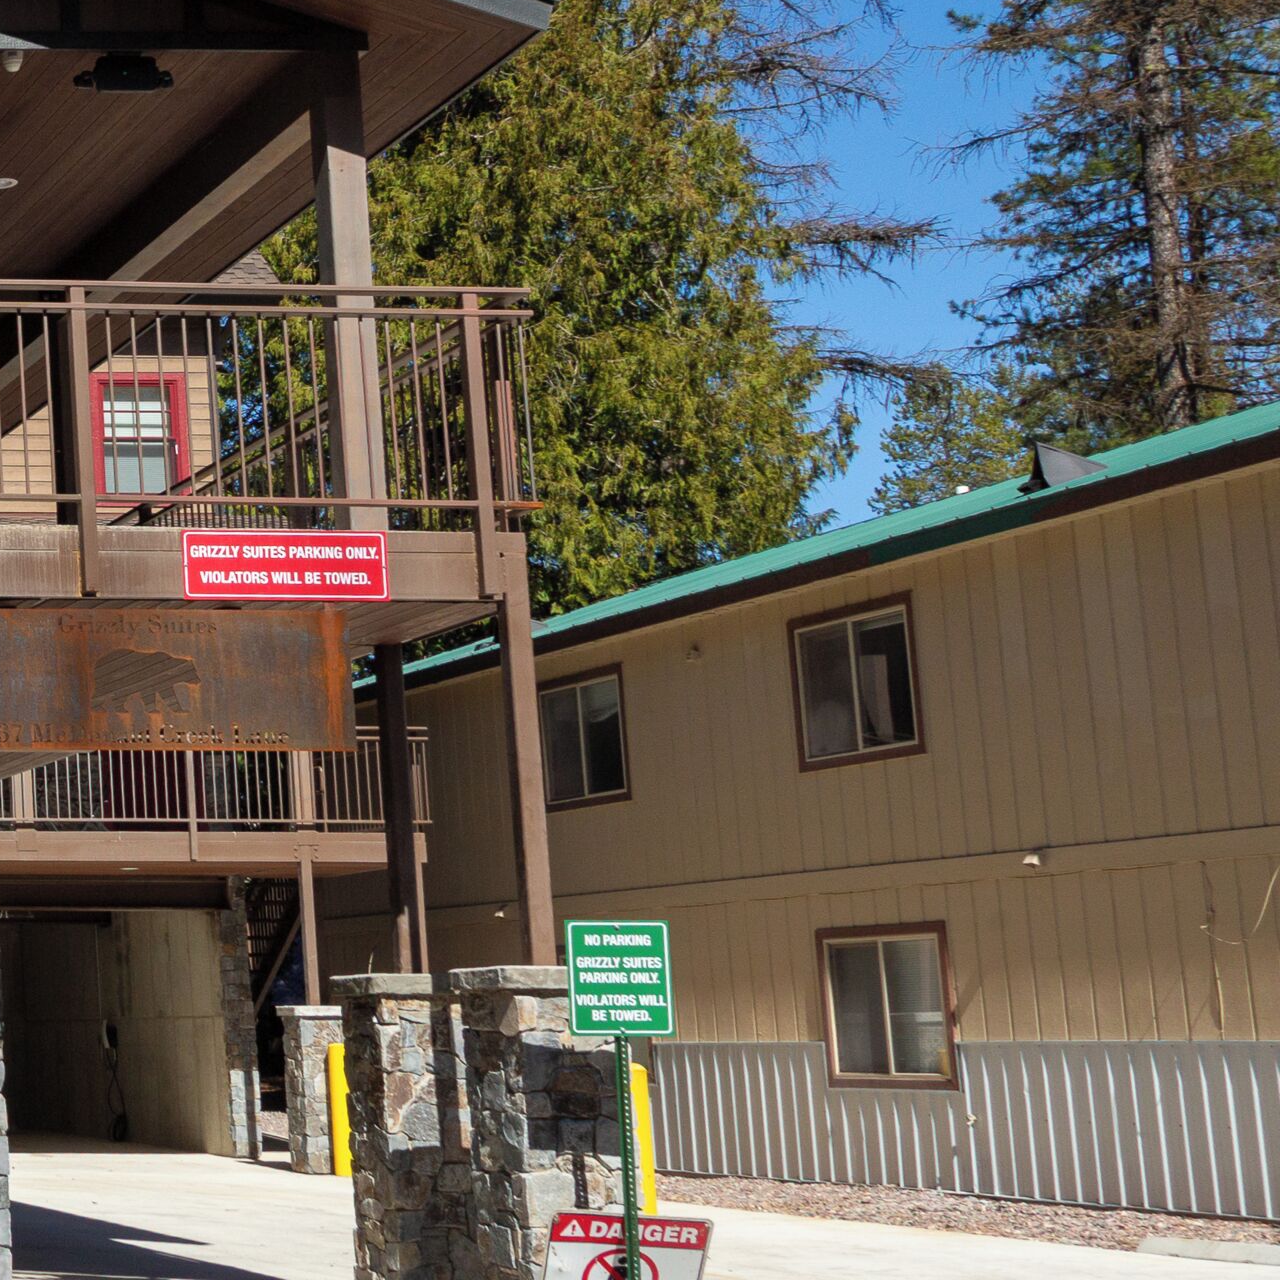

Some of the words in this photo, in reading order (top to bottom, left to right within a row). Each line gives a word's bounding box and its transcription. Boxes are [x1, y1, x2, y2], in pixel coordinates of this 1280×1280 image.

[190, 545, 240, 559] GRIZZLY
[242, 545, 286, 559] SUITES
[289, 546, 342, 560] PARKING
[345, 546, 379, 560] ONLY.
[200, 571, 268, 585] VIOLATORS
[271, 572, 302, 585] WILL
[304, 572, 321, 585] BE
[323, 572, 371, 585] TOWED.
[57, 614, 139, 640] Grizzly
[147, 614, 217, 634] Suites
[159, 722, 224, 744] Creek
[232, 722, 289, 744] Lane
[584, 934, 600, 946] NO
[602, 934, 651, 946] PARKING
[576, 957, 620, 968] GRIZZLY
[622, 957, 662, 968] SUITES
[579, 972, 628, 984] PARKING
[630, 972, 661, 984] ONLY.
[576, 994, 637, 1006] VIOLATORS
[638, 994, 667, 1006] WILL
[591, 1010, 607, 1021] BE
[609, 1010, 652, 1022] TOWED.
